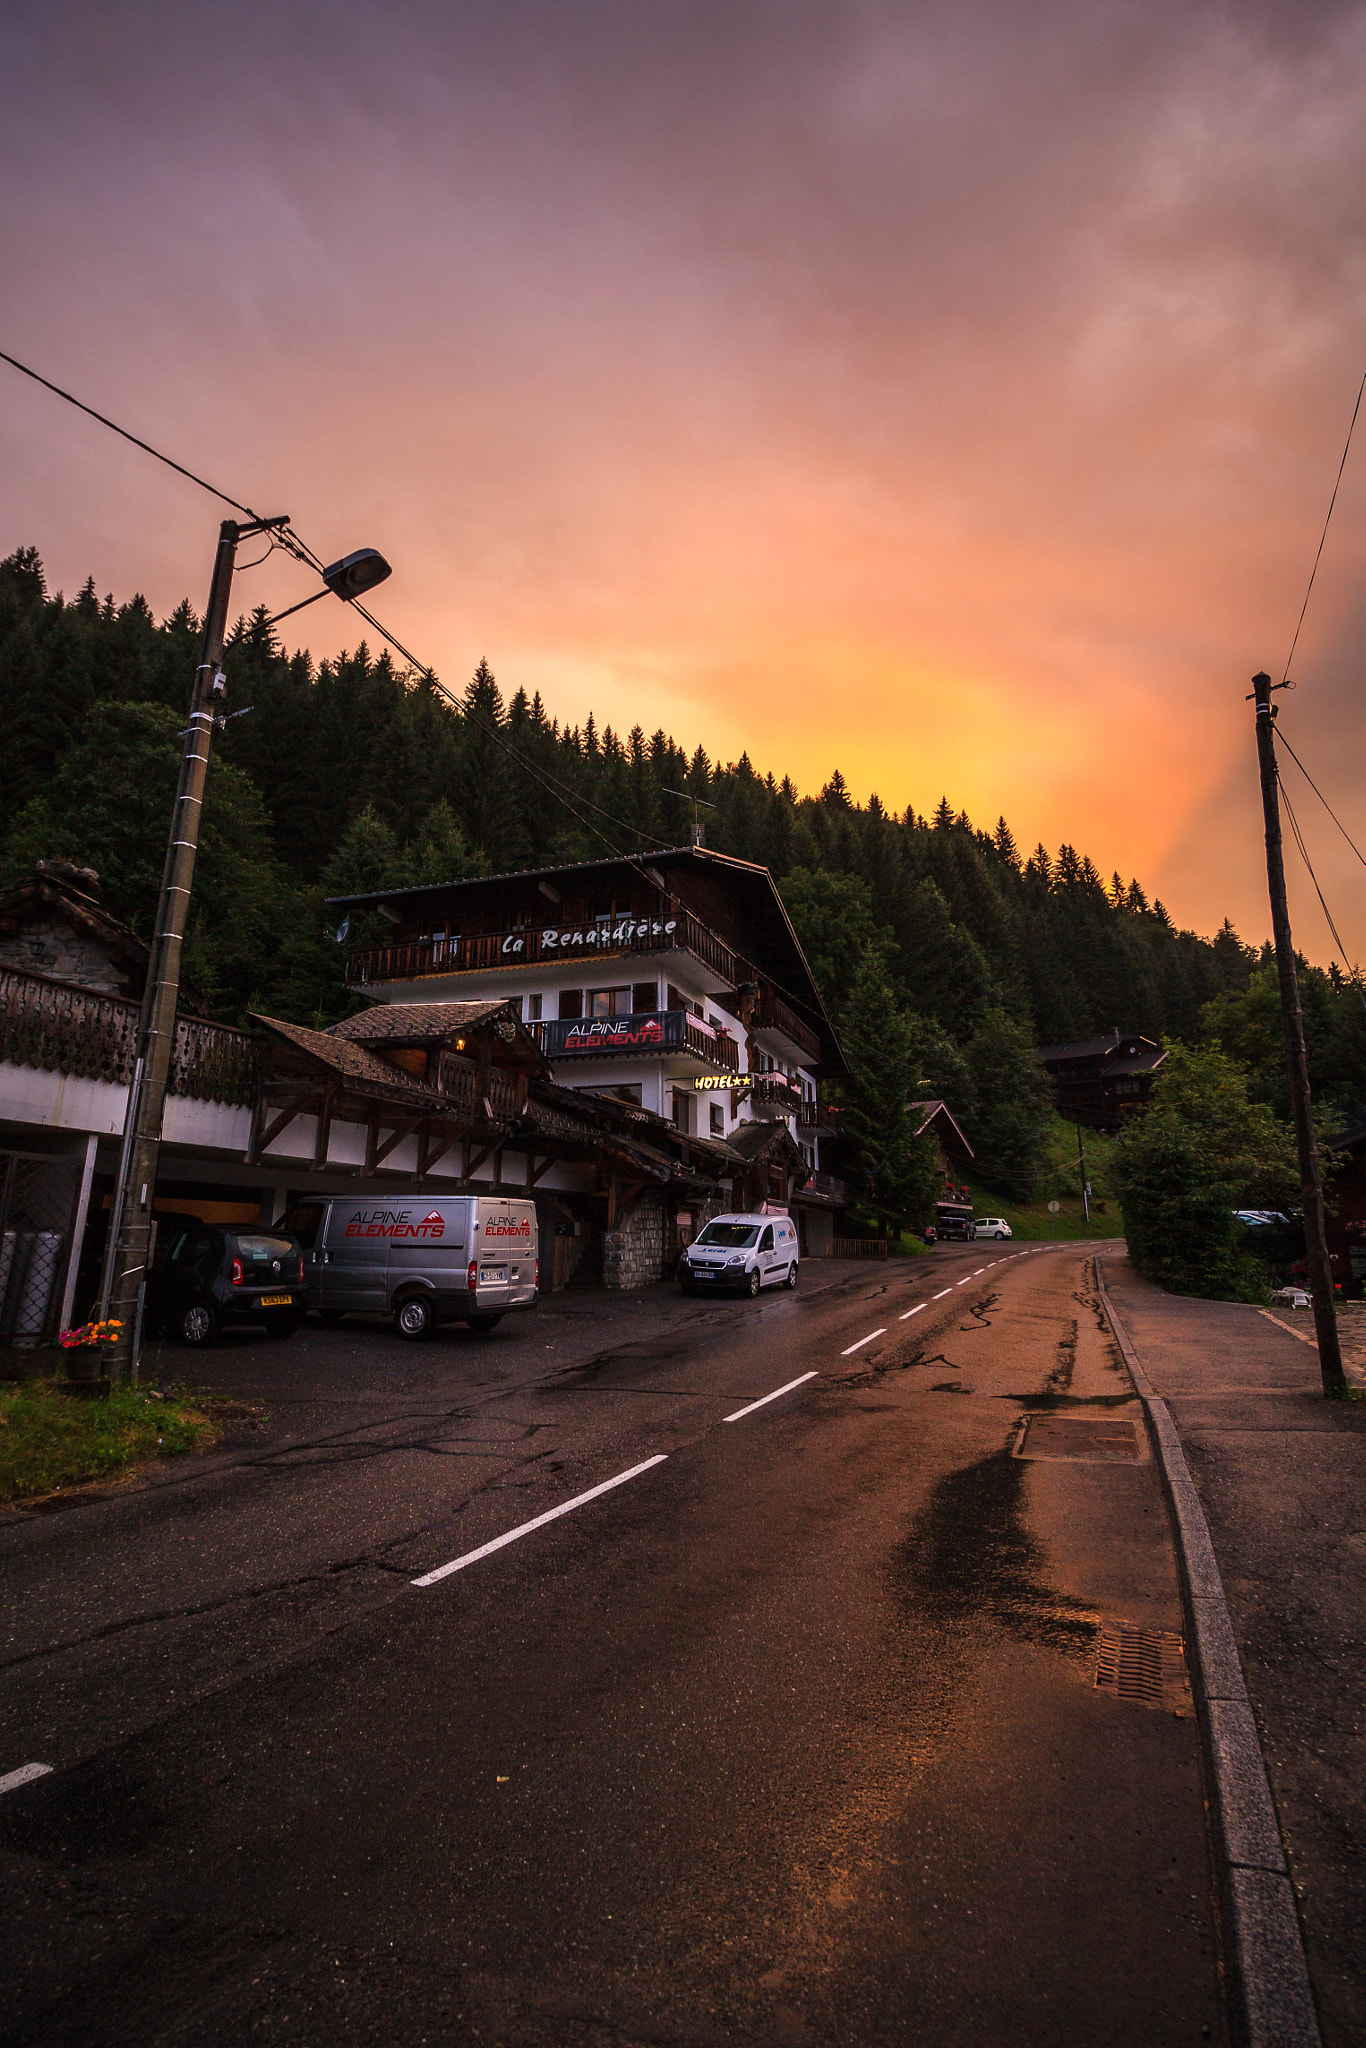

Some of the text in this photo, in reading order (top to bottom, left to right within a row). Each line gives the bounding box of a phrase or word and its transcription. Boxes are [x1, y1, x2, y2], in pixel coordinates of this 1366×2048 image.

[502, 936, 524, 953] La
[567, 1021, 630, 1037] ALPINE
[564, 1029, 664, 1049] ELEMENTS
[694, 1075, 733, 1090] HOTEL
[349, 1211, 412, 1224] ALPINE
[486, 1216, 517, 1226] ALPINE
[344, 1224, 445, 1238] ELEMENTS
[485, 1226, 531, 1237] ELEMENTS
